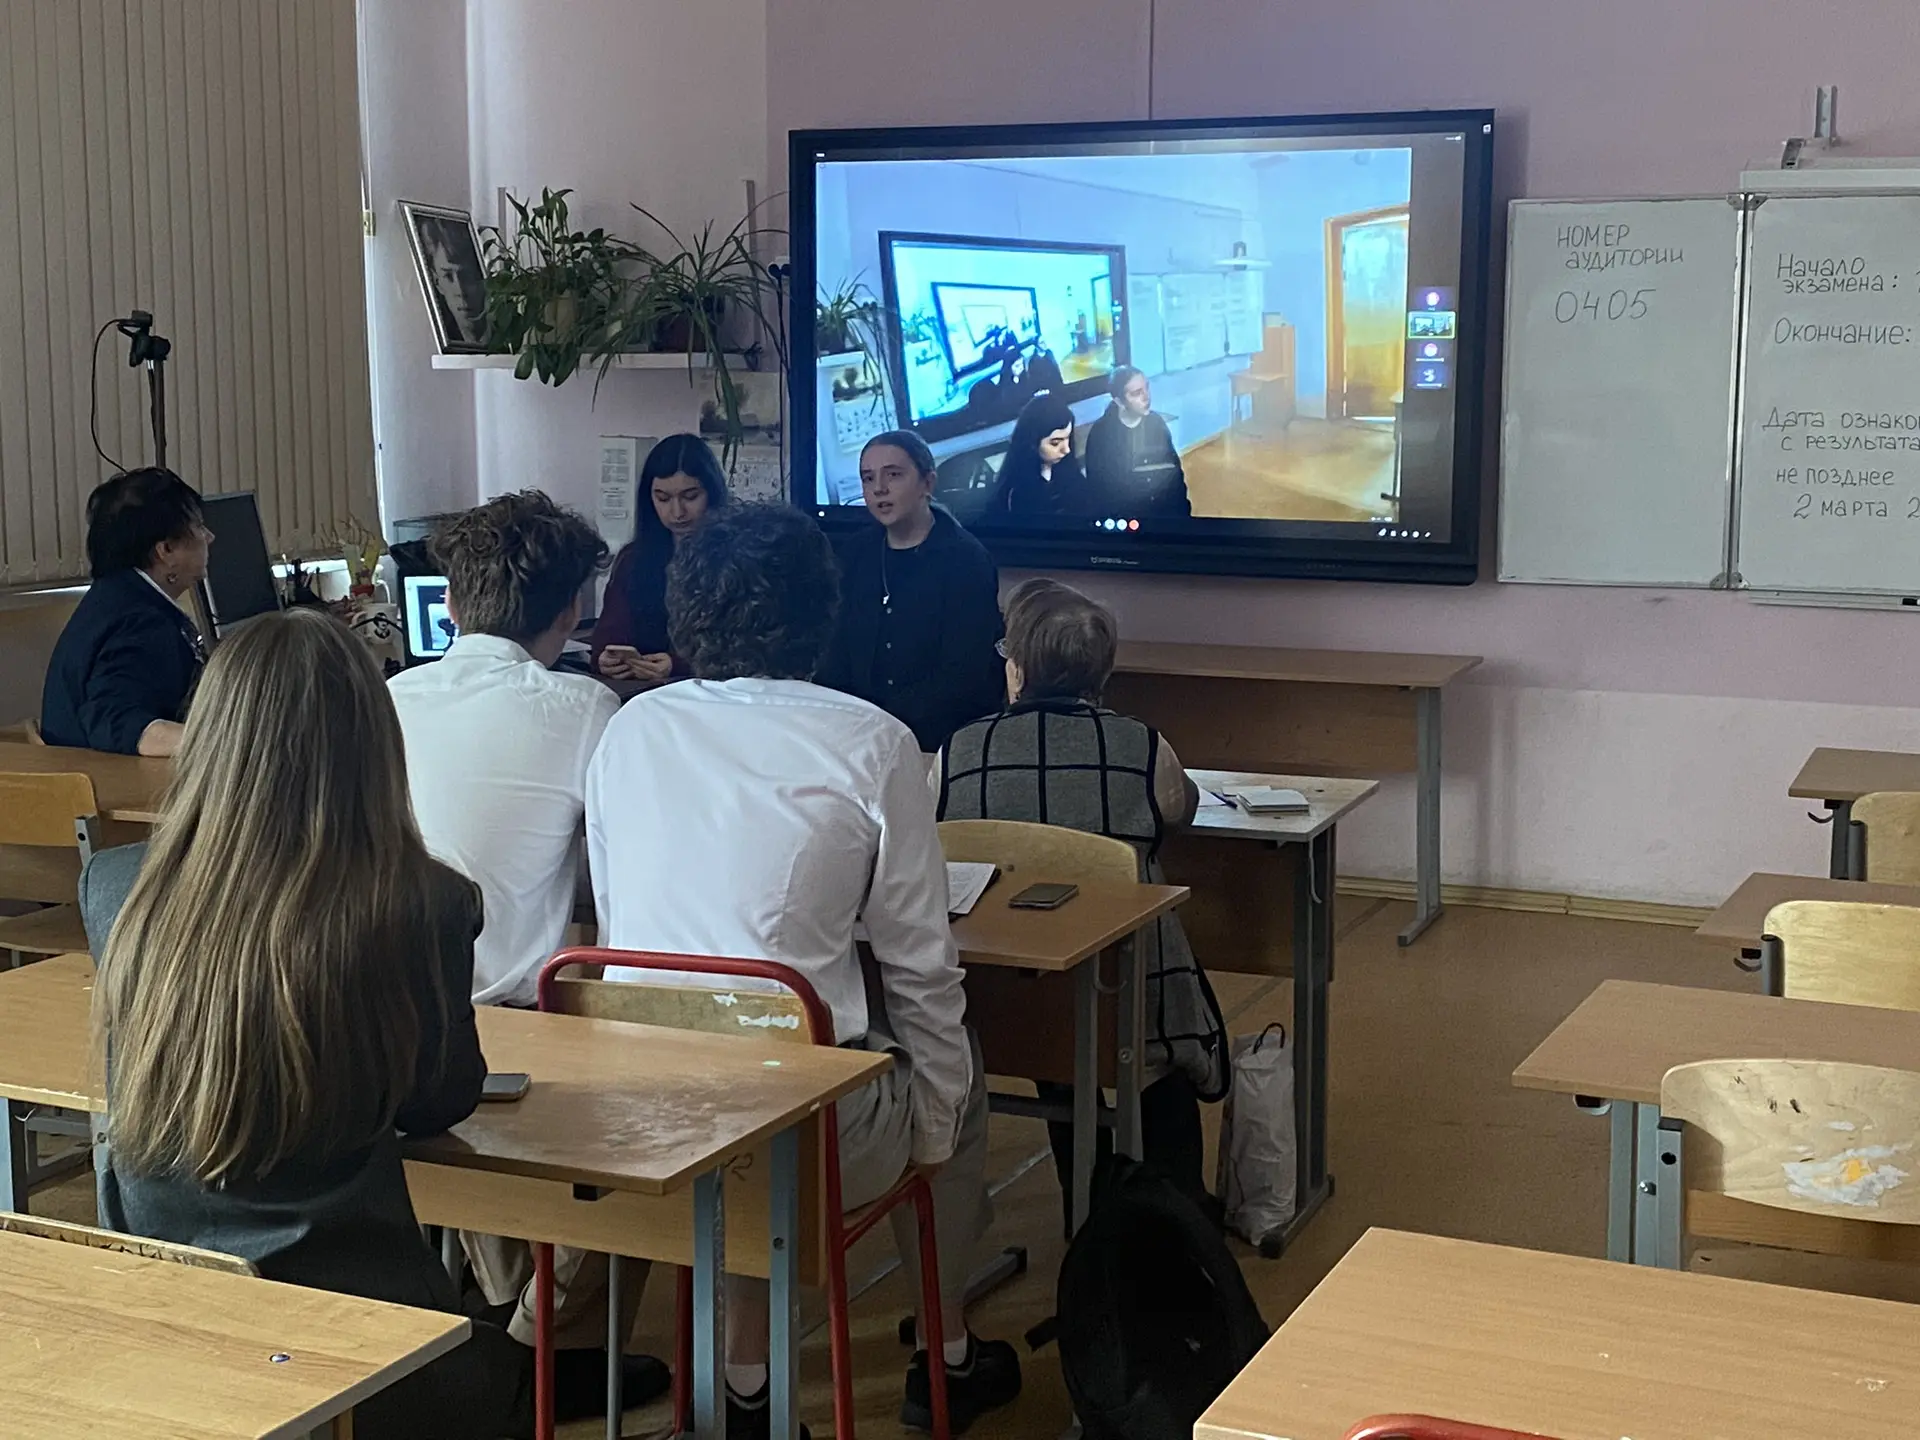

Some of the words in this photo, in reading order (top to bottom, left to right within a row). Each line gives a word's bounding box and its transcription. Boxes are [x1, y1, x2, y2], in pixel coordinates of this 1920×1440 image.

[1556, 223, 1630, 249] НОМЕР
[1776, 252, 1866, 279] Начало
[1554, 288, 1657, 324] 0405
[1774, 316, 1912, 345] Окончание:
[1761, 406, 1825, 433] Дата
[1840, 411, 1920, 431] ознако
[1780, 435, 1793, 451] с
[1775, 467, 1799, 485] не
[1806, 467, 1895, 488] позднее
[1793, 492, 1812, 520] 2
[1821, 499, 1888, 518] марта
